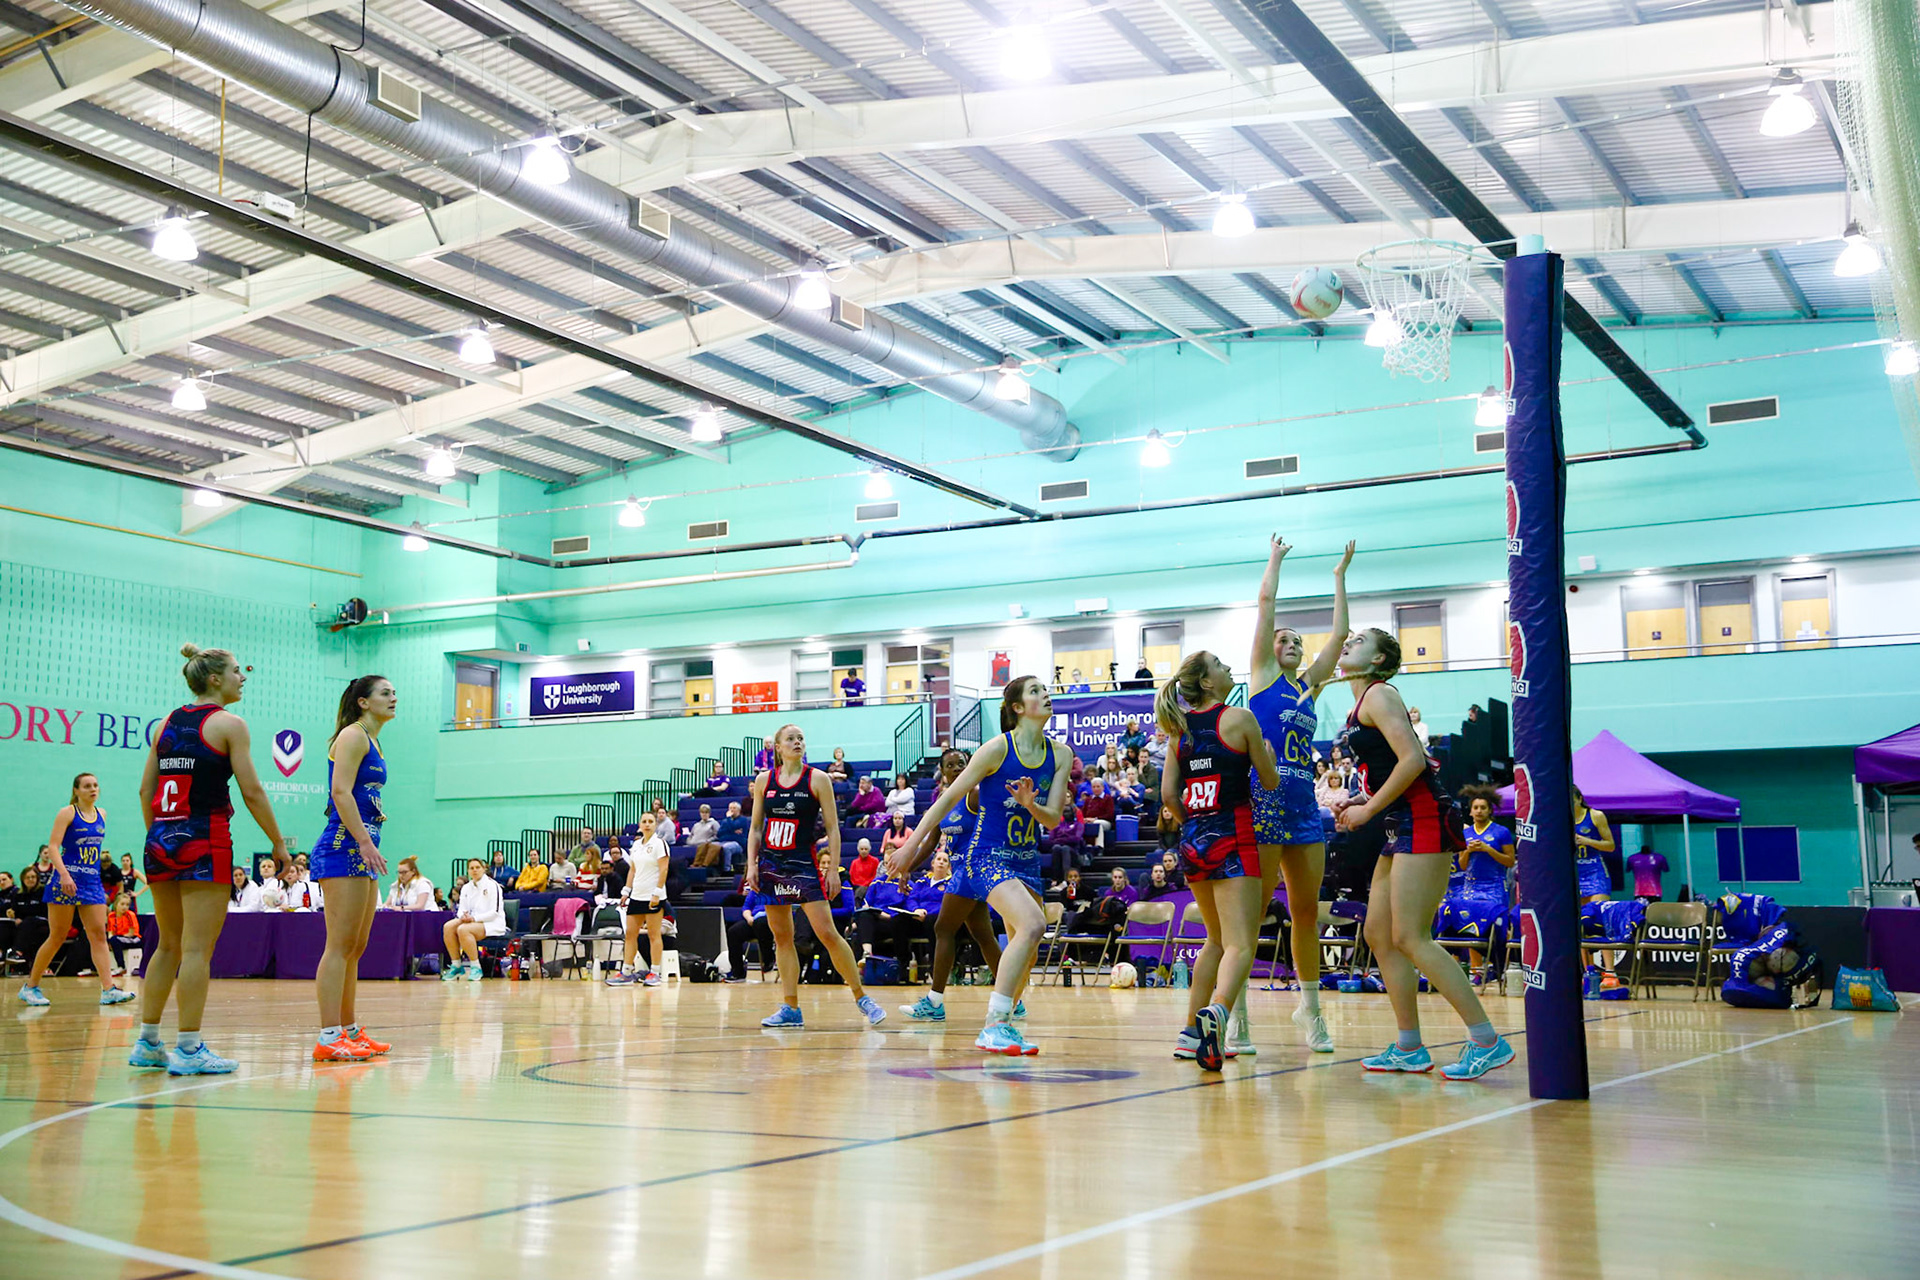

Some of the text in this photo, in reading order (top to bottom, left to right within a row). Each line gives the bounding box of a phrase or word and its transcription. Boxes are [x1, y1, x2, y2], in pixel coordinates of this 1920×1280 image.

[562, 680, 621, 695] Loughborough
[562, 692, 603, 705] University
[1284, 730, 1311, 767] GS
[1189, 757, 1212, 771] BRIGHT
[161, 780, 178, 812] C
[768, 821, 796, 848] WD
[1007, 815, 1036, 847] GA
[773, 882, 801, 898] Vitality
